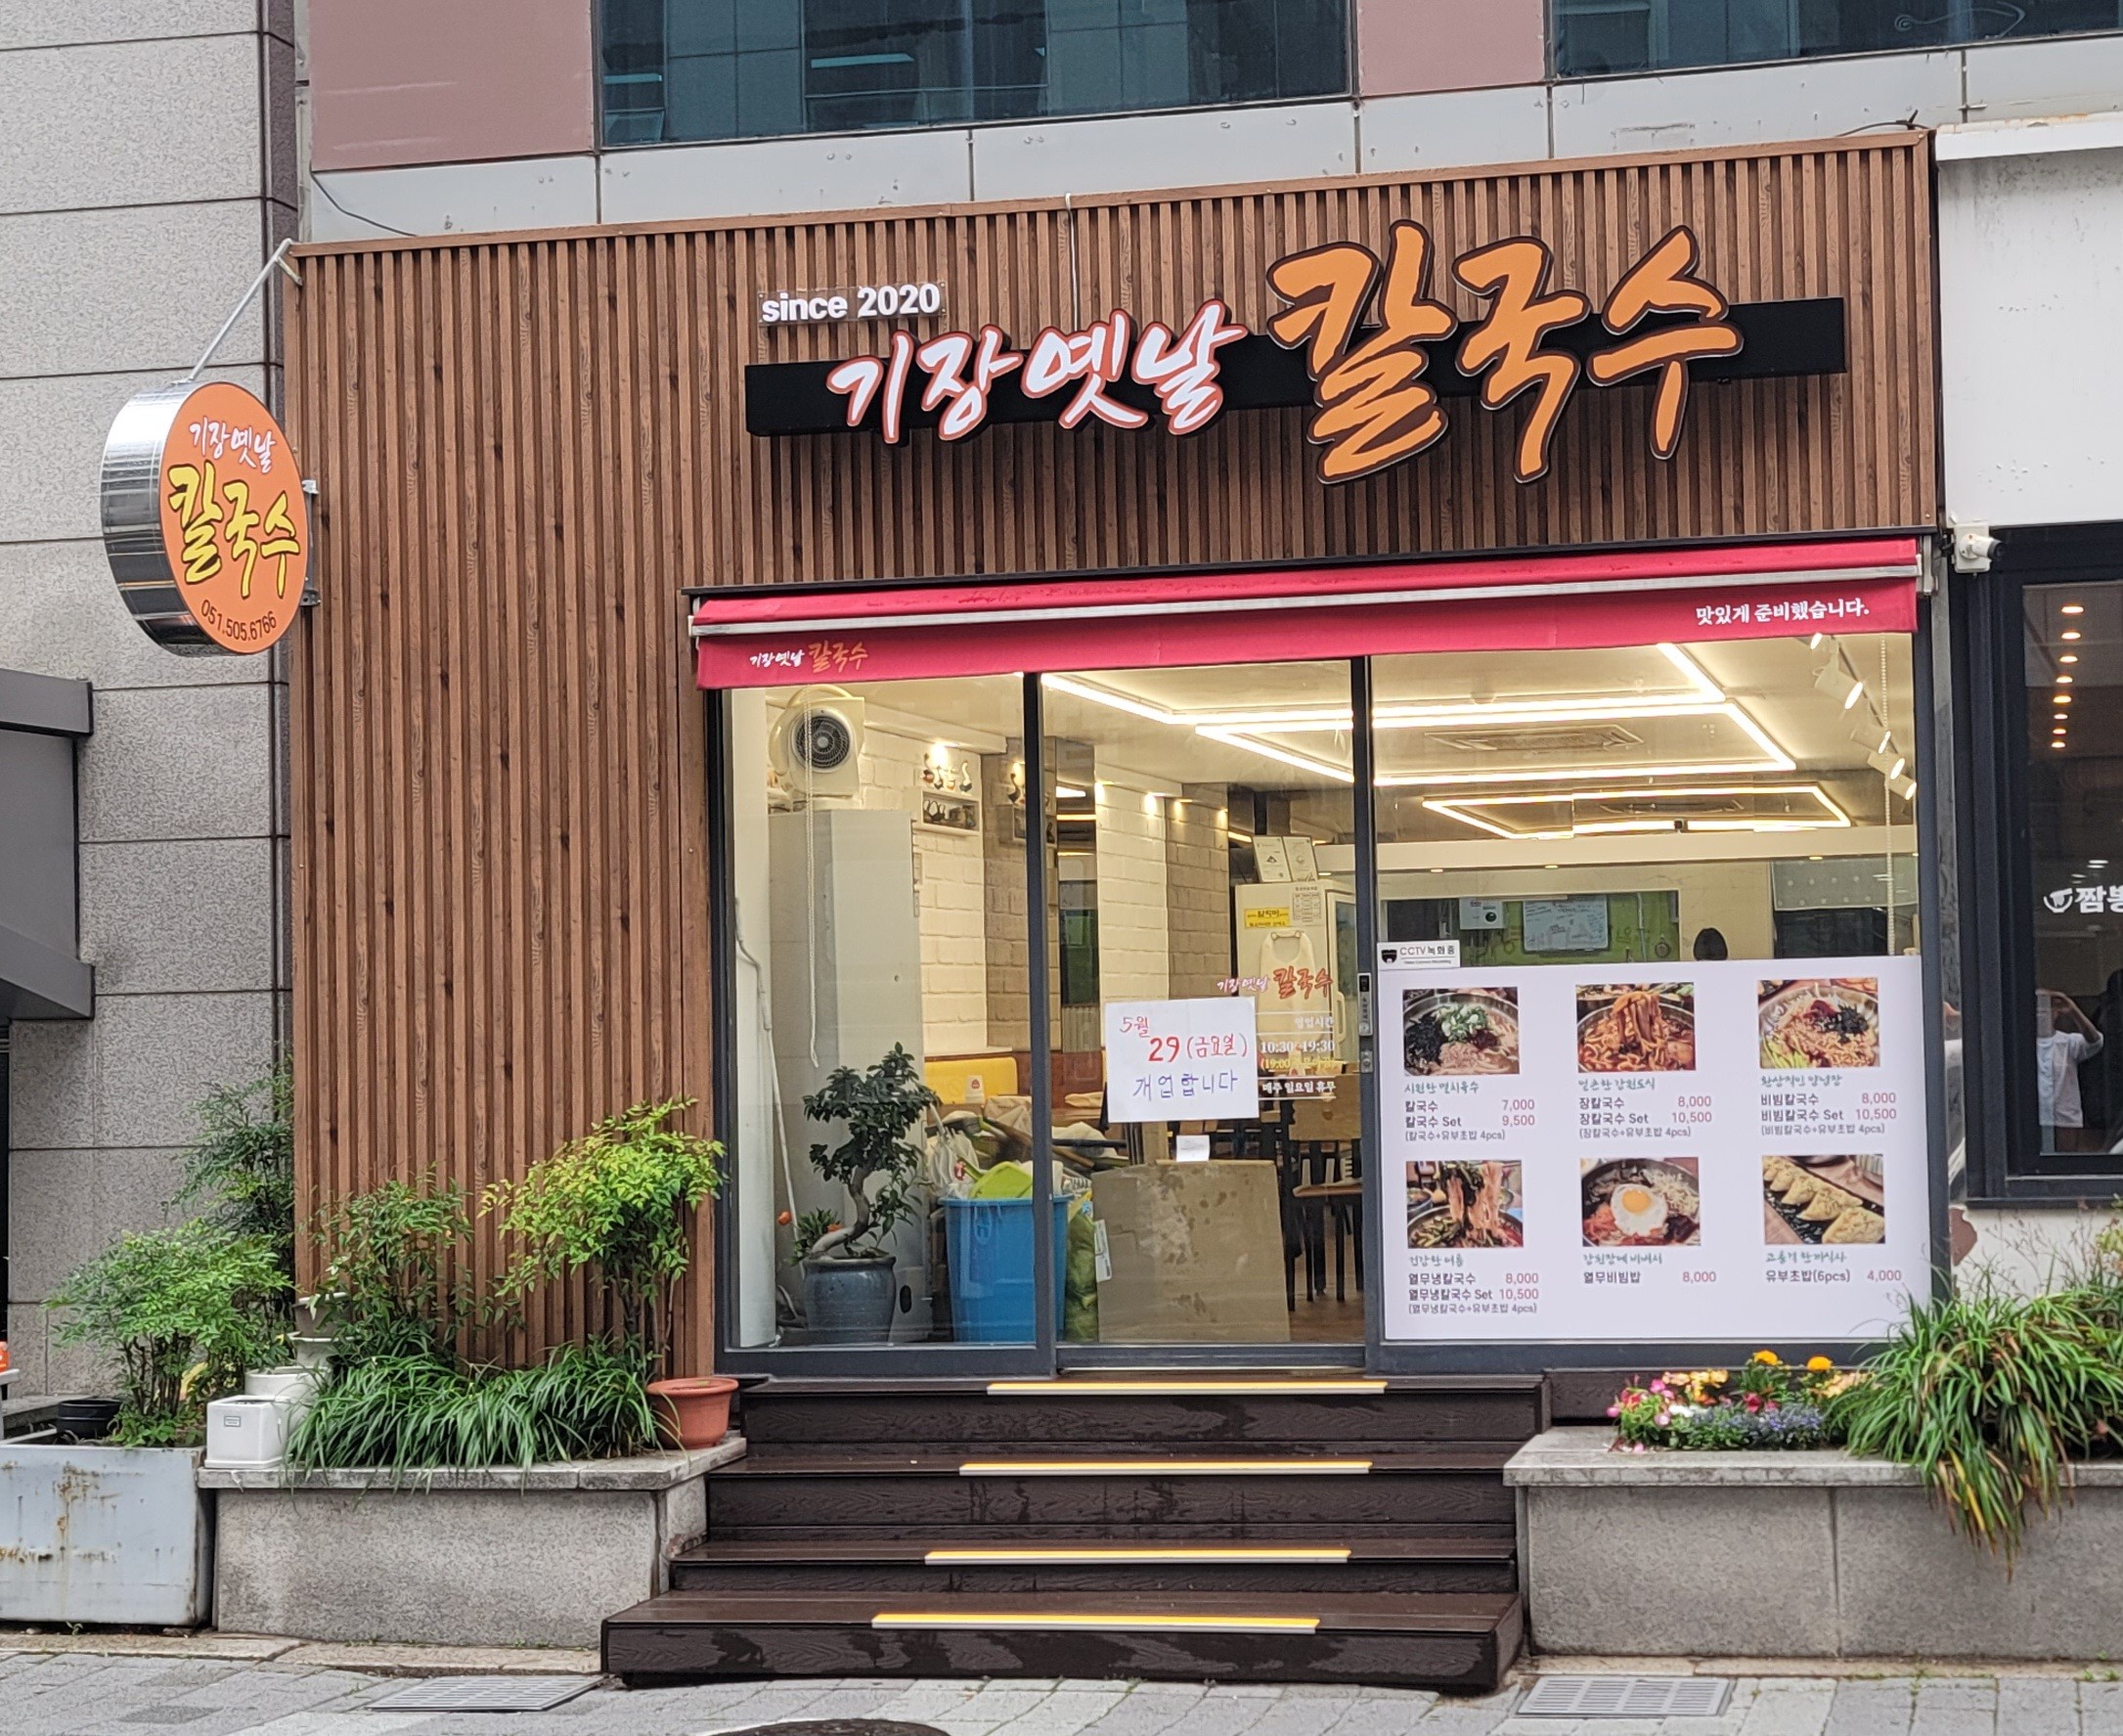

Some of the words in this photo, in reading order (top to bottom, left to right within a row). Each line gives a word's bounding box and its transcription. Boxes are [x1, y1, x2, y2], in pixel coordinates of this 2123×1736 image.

[762, 292, 849, 323] since
[858, 284, 940, 317] 2020
[1267, 219, 1744, 483] 칼국수
[168, 460, 300, 600] 칼국수
[1696, 603, 1750, 626] 맛있게
[1754, 598, 1870, 622] 준비했습니다.
[200, 600, 278, 641] 051.505.6766
[808, 640, 868, 673] 칼국수
[1273, 966, 1333, 1000] 칼국수
[1120, 1016, 1151, 1038] 5월
[1285, 1081, 1313, 1093] 일요일
[1405, 1100, 1438, 1112] 칼국수
[1502, 1099, 1535, 1111] 7,000
[1579, 1096, 1624, 1109] 장칼국수
[1678, 1095, 1711, 1108] 8,000
[1761, 1093, 1819, 1106] 비빔칼국수
[1862, 1092, 1896, 1104] 8,000
[1405, 1116, 1438, 1128] 칼국수
[1442, 1116, 1461, 1127] Set
[1502, 1115, 1535, 1127] 9,500
[1579, 1112, 1625, 1125] 장칼국수
[1629, 1113, 1649, 1124] Set
[1672, 1111, 1712, 1124] 10,500
[1761, 1109, 1819, 1122] 비빔칼국수
[1824, 1109, 1843, 1121] Set
[1856, 1108, 1897, 1121] 10,500
[1408, 1272, 1477, 1285] 열무냉칼국수
[1506, 1272, 1539, 1284] 8,000
[1583, 1270, 1641, 1283] 열무비빔밥
[1682, 1271, 1716, 1283] 8,000
[1867, 1269, 1902, 1281] 4,000
[1408, 1289, 1472, 1301] 열무냉칼국수
[1475, 1289, 1493, 1300] Set
[1499, 1288, 1539, 1301] 10,500
